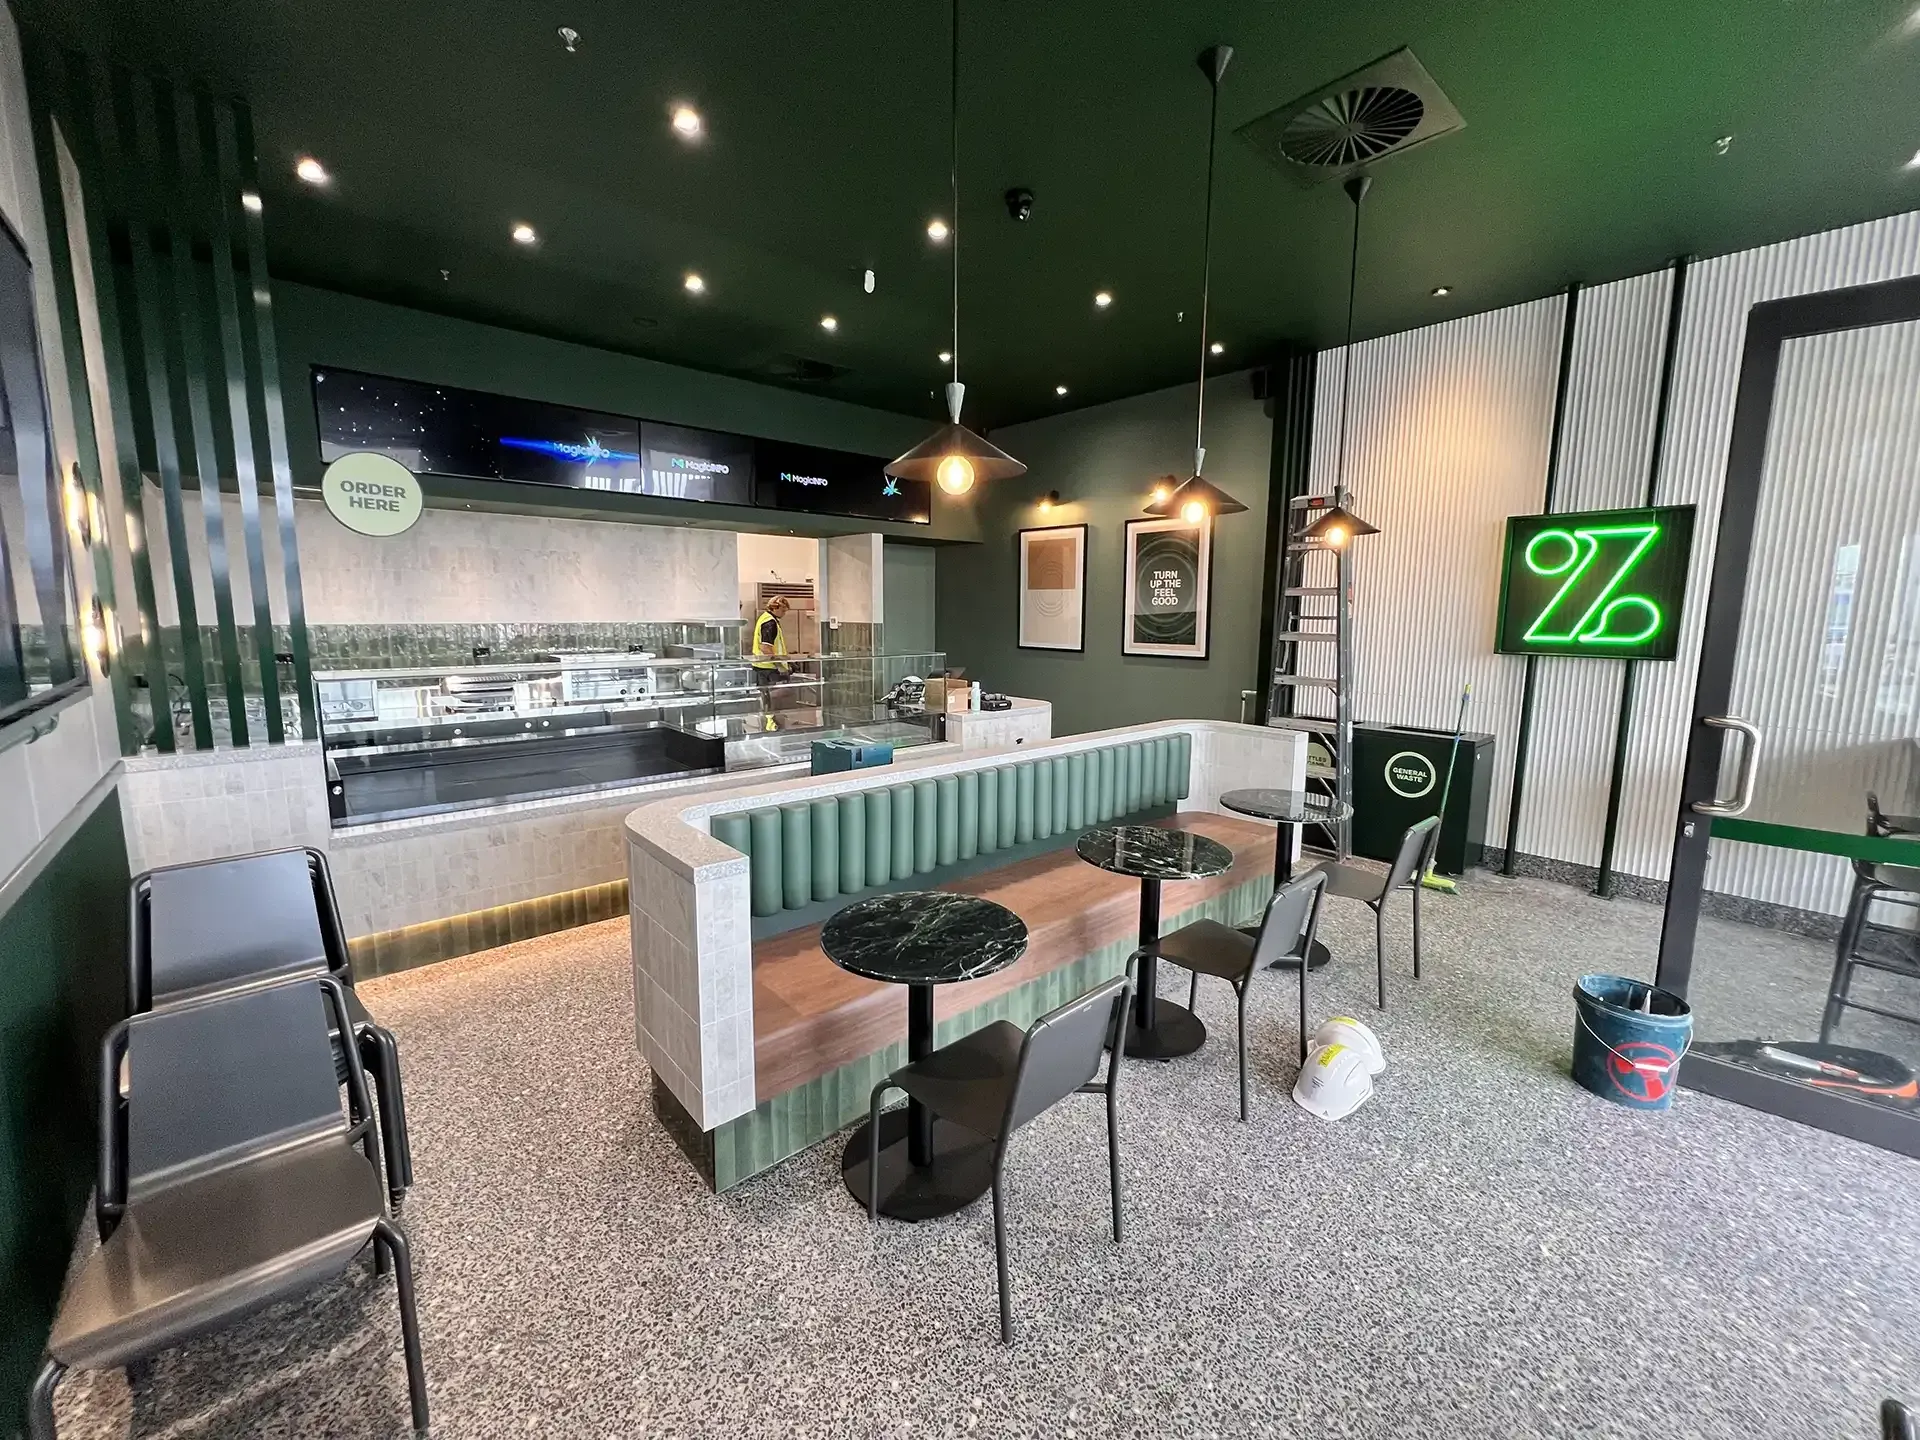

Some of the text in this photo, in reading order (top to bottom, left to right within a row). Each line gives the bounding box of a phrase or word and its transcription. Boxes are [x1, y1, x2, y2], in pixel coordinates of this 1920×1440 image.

[553, 442, 610, 458] MagicO
[340, 479, 407, 500] ORDER
[349, 496, 401, 512] HERE
[1153, 570, 1178, 579] TURN
[1150, 579, 1181, 588] UP THE
[1154, 588, 1176, 596] FEEL
[1151, 597, 1178, 605] GOOD
[1307, 755, 1327, 763] TTLES
[1392, 767, 1427, 777] GENERAL
[1396, 774, 1423, 782] WASTE
